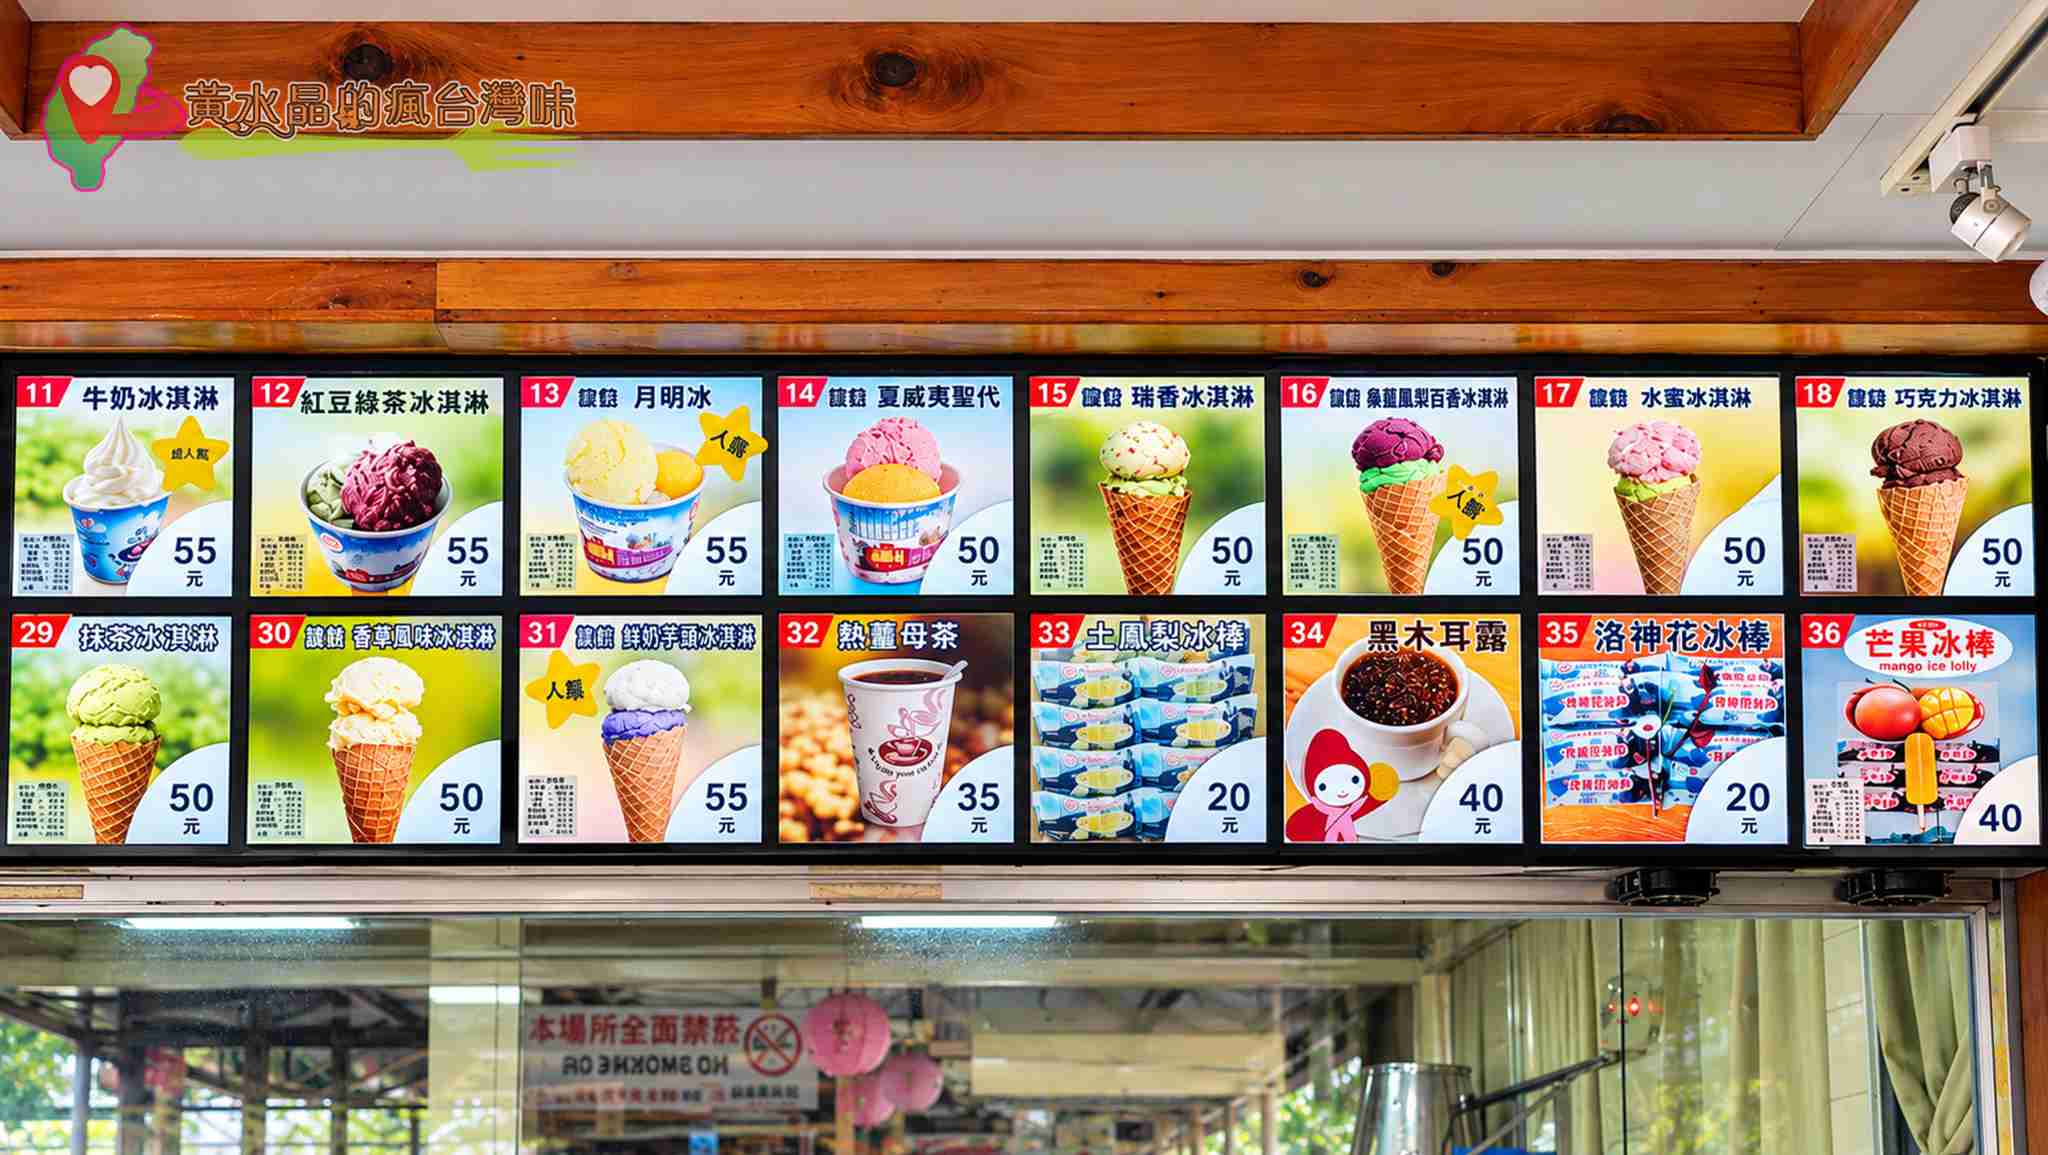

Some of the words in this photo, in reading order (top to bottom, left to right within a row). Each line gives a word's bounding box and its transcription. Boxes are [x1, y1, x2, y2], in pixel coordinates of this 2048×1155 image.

[25, 383, 54, 404] 11
[83, 386, 219, 411] 牛奶冰淇淋
[260, 383, 291, 404] 12
[300, 390, 489, 415] 紅豆綠茶冰淇淋
[529, 383, 560, 405] 13
[634, 385, 711, 409] 月明冰
[785, 383, 815, 404] 14
[878, 385, 1000, 408] 夏威夷聖代
[1038, 383, 1067, 404] 15
[1132, 385, 1254, 408] 瑞香冰淇淋
[1288, 383, 1318, 404] 16
[1542, 383, 1571, 404] 17
[1803, 383, 1832, 404] 18
[1894, 388, 2022, 408] 巧克力冰淇淋
[174, 537, 216, 564] 55
[447, 537, 489, 564] 55
[706, 537, 747, 564] 55
[959, 537, 999, 564] 50
[1213, 537, 1253, 564] 50
[1463, 537, 1503, 564] 50
[1724, 537, 1765, 564] 50
[1982, 537, 2022, 564] 50
[185, 571, 203, 587] 元
[460, 571, 478, 587] 元
[718, 571, 735, 587] 元
[971, 571, 988, 587] 元
[1224, 571, 1241, 587] 元
[1476, 571, 1492, 587] 元
[1738, 571, 1754, 587] 元
[1995, 571, 2011, 587] 元
[19, 622, 54, 645] 29
[79, 623, 219, 652] 抹茶冰淇淋
[257, 622, 291, 645] 30
[352, 623, 496, 649] 香草風味冰淇淋
[527, 621, 557, 644] 31
[622, 623, 756, 649] 鮮奶芋頭冰淇淋
[786, 621, 819, 644] 32
[837, 620, 959, 651] 熱薑母茶
[1038, 621, 1070, 644] 33
[1086, 620, 1246, 651] 土鳳梨冰棒
[1290, 621, 1323, 644] 34
[1368, 620, 1507, 652] 黑木耳露
[1545, 621, 1579, 644] 35
[1594, 620, 1770, 652] 洛神花冰棒
[1808, 621, 1841, 644] 36
[1865, 629, 1995, 658] 芒果冰棒
[1879, 661, 1922, 673] mango
[1928, 660, 1946, 671] ice
[1951, 660, 1977, 673] lolly
[169, 784, 214, 812] 50
[440, 784, 483, 812] 50
[706, 784, 747, 812] 55
[958, 784, 999, 812] 35
[1208, 784, 1250, 812] 20
[1459, 784, 1503, 812] 40
[1726, 784, 1771, 812] 20
[184, 818, 200, 834] 元
[453, 818, 470, 834] 元
[718, 818, 735, 834] 元
[971, 818, 987, 834] 元
[1222, 818, 1238, 834] 元
[1475, 818, 1491, 834] 元
[1741, 818, 1758, 834] 元
[1979, 804, 2023, 833] 40
